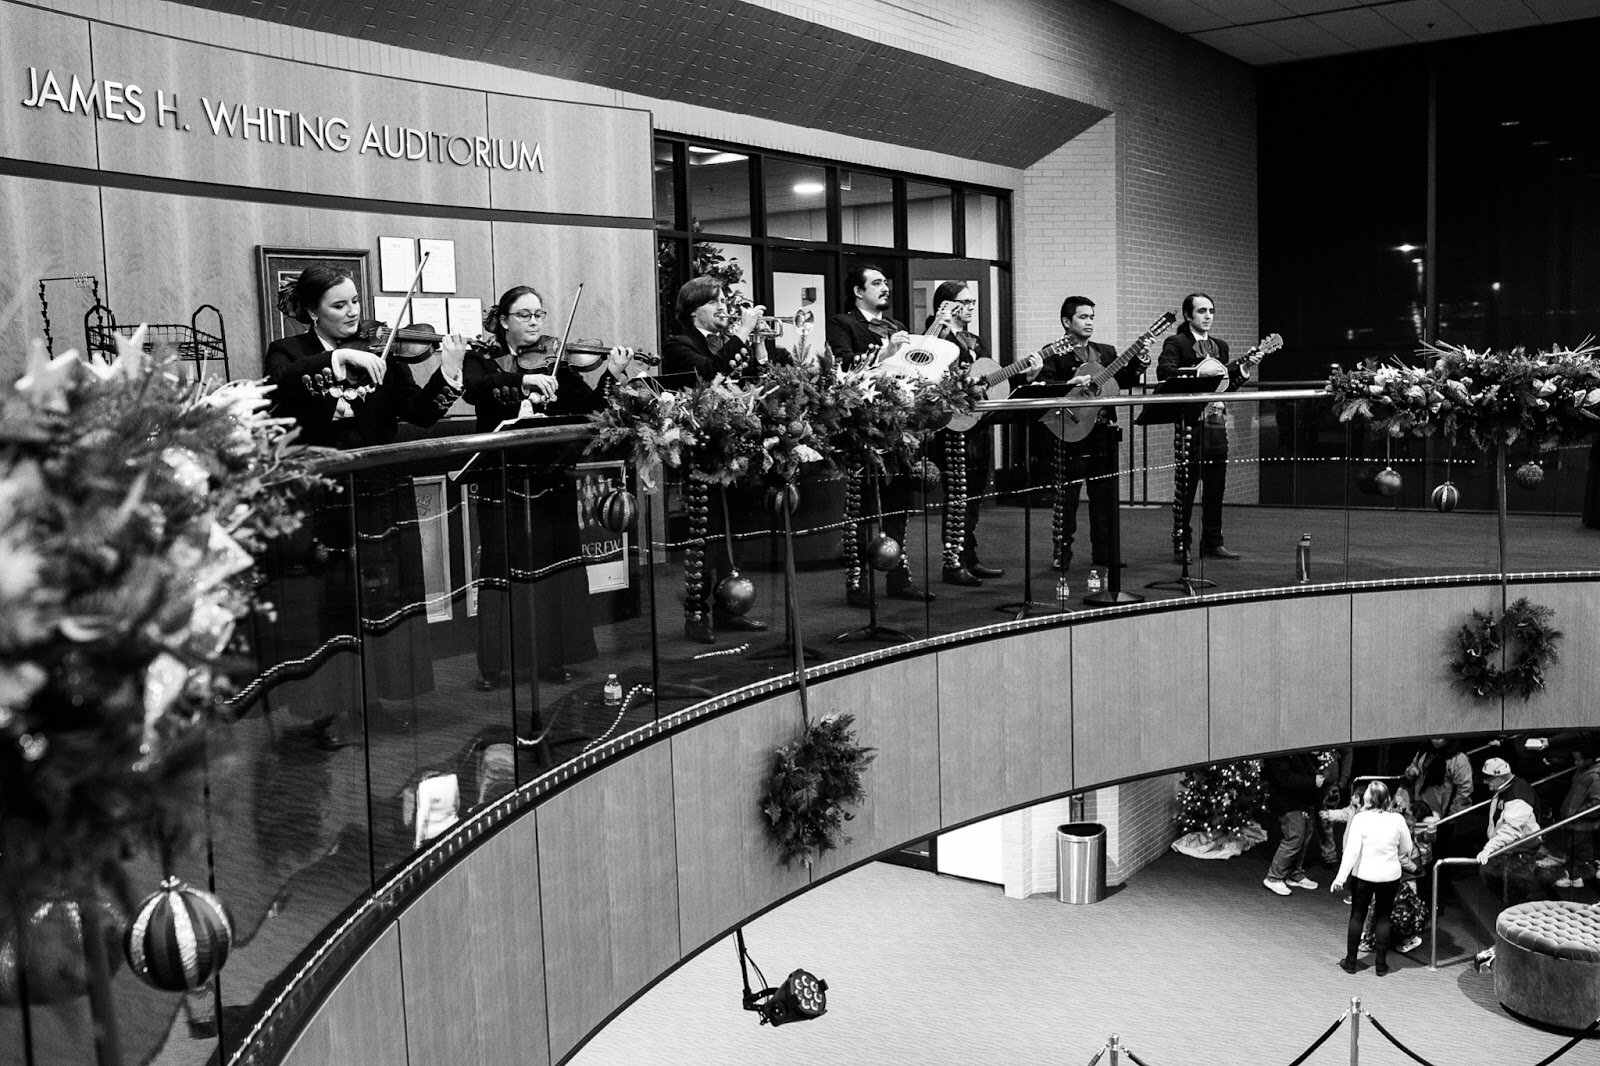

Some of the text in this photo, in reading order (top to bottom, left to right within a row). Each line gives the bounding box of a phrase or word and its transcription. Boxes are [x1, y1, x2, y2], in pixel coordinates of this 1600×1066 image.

[22, 66, 545, 172] JAMES H. WHITING AUDITORIUM
